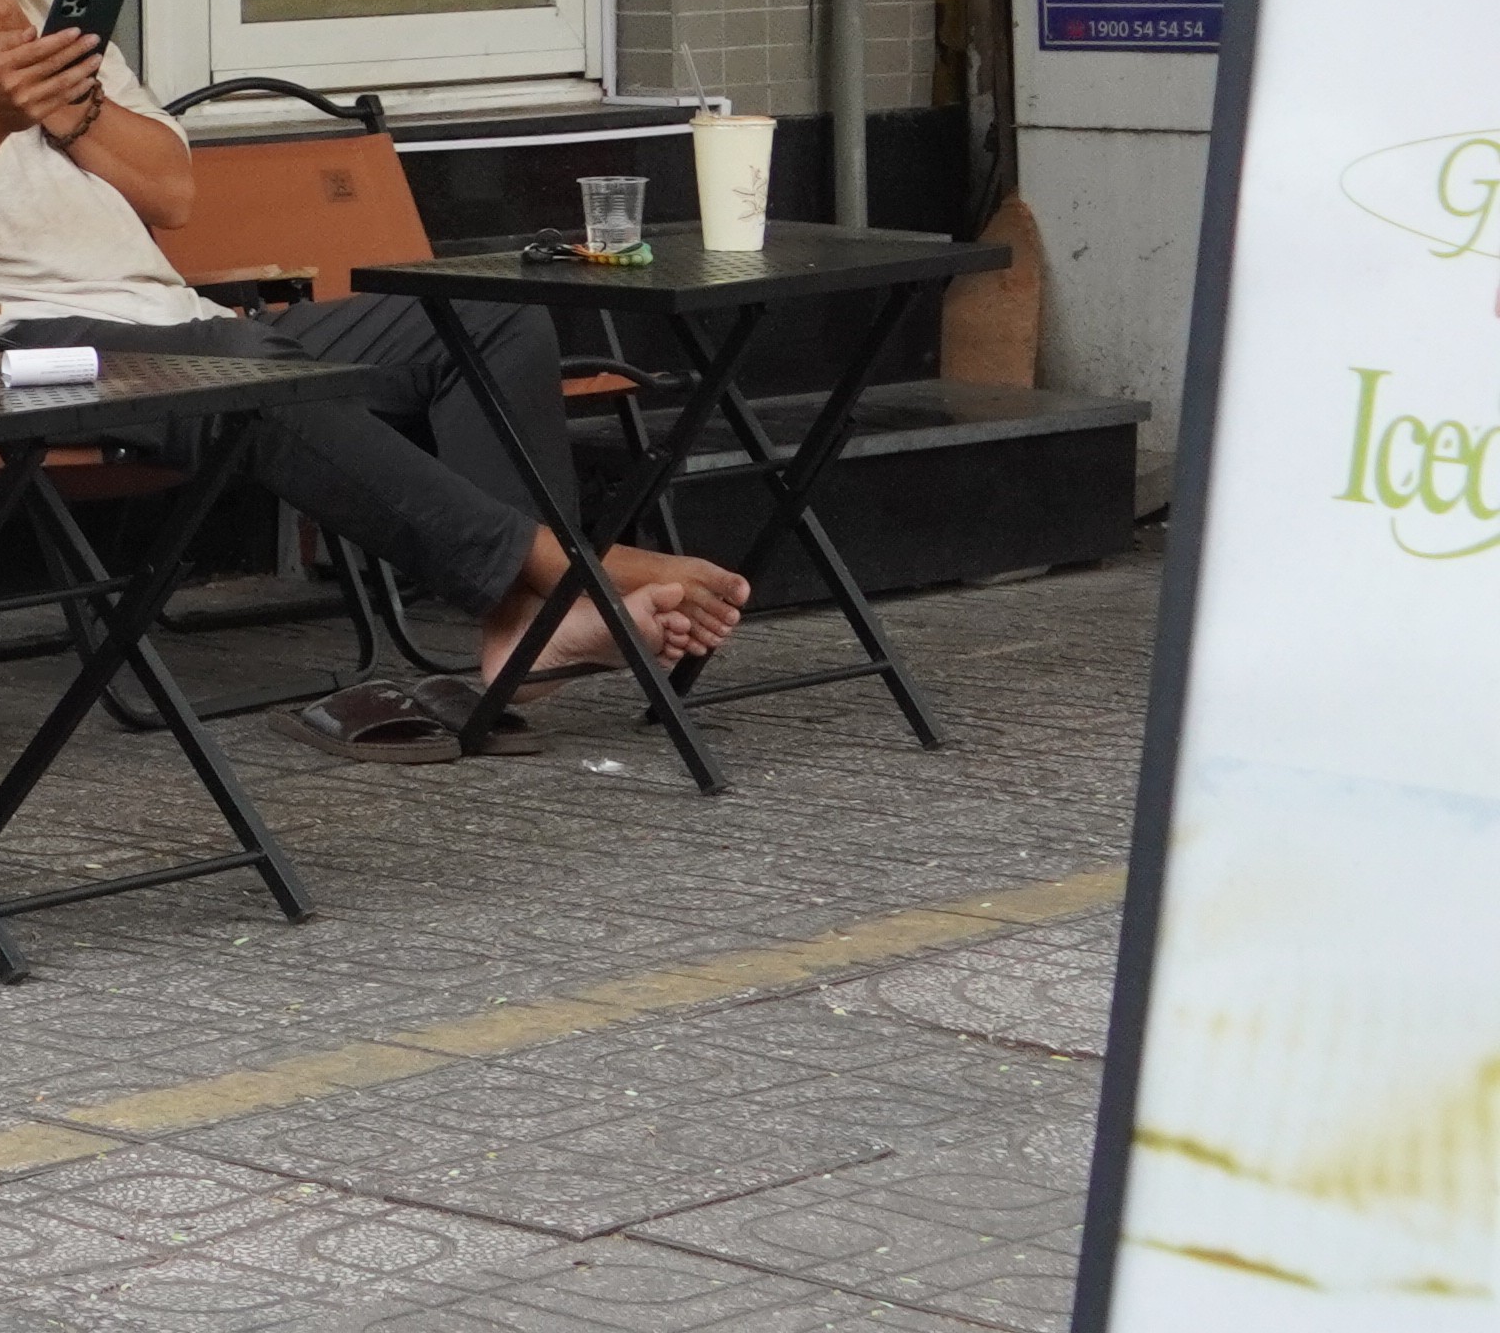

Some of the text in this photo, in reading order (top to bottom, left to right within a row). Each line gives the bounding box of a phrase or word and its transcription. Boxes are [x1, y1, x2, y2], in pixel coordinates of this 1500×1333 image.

[1088, 20, 1205, 38] 1900 54 54 54
